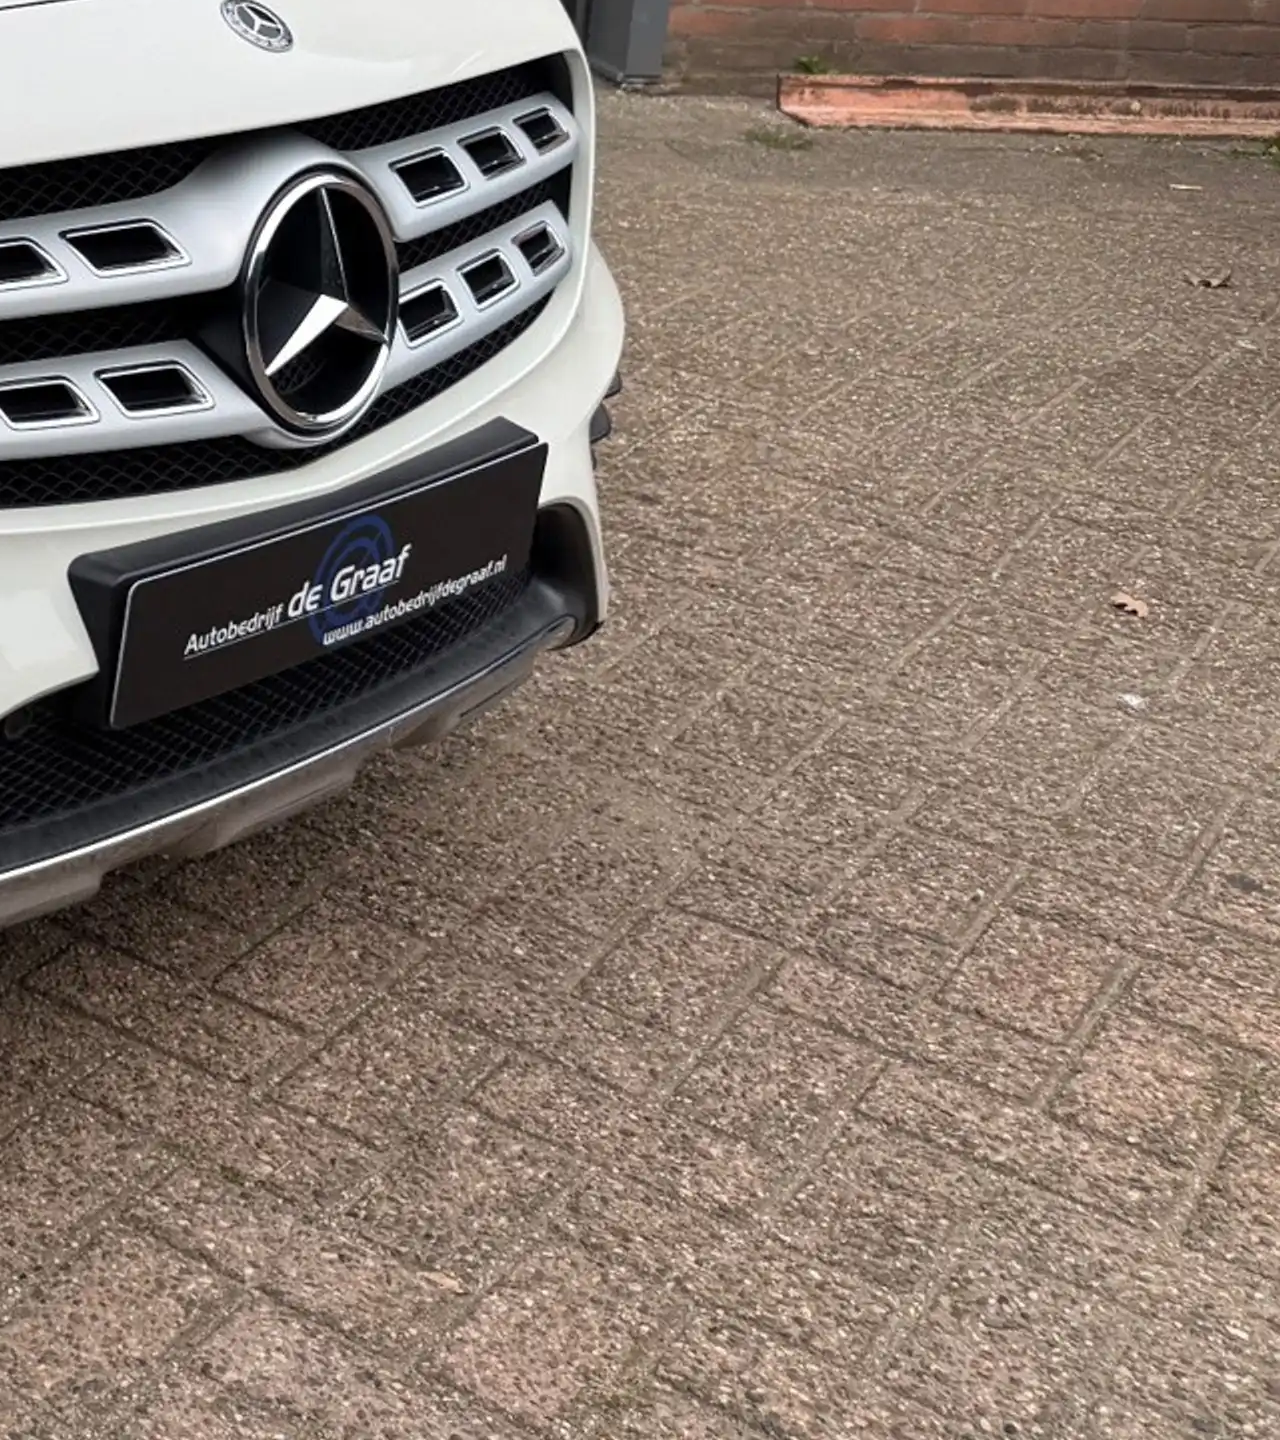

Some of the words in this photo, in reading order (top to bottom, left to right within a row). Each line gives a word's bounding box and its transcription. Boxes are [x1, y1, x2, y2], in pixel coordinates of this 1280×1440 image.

[184, 603, 283, 655] Autobedrijf
[288, 581, 323, 617] de
[330, 544, 412, 601] Graaf
[323, 555, 507, 645] www.autobedrijfdegraaf.nl
